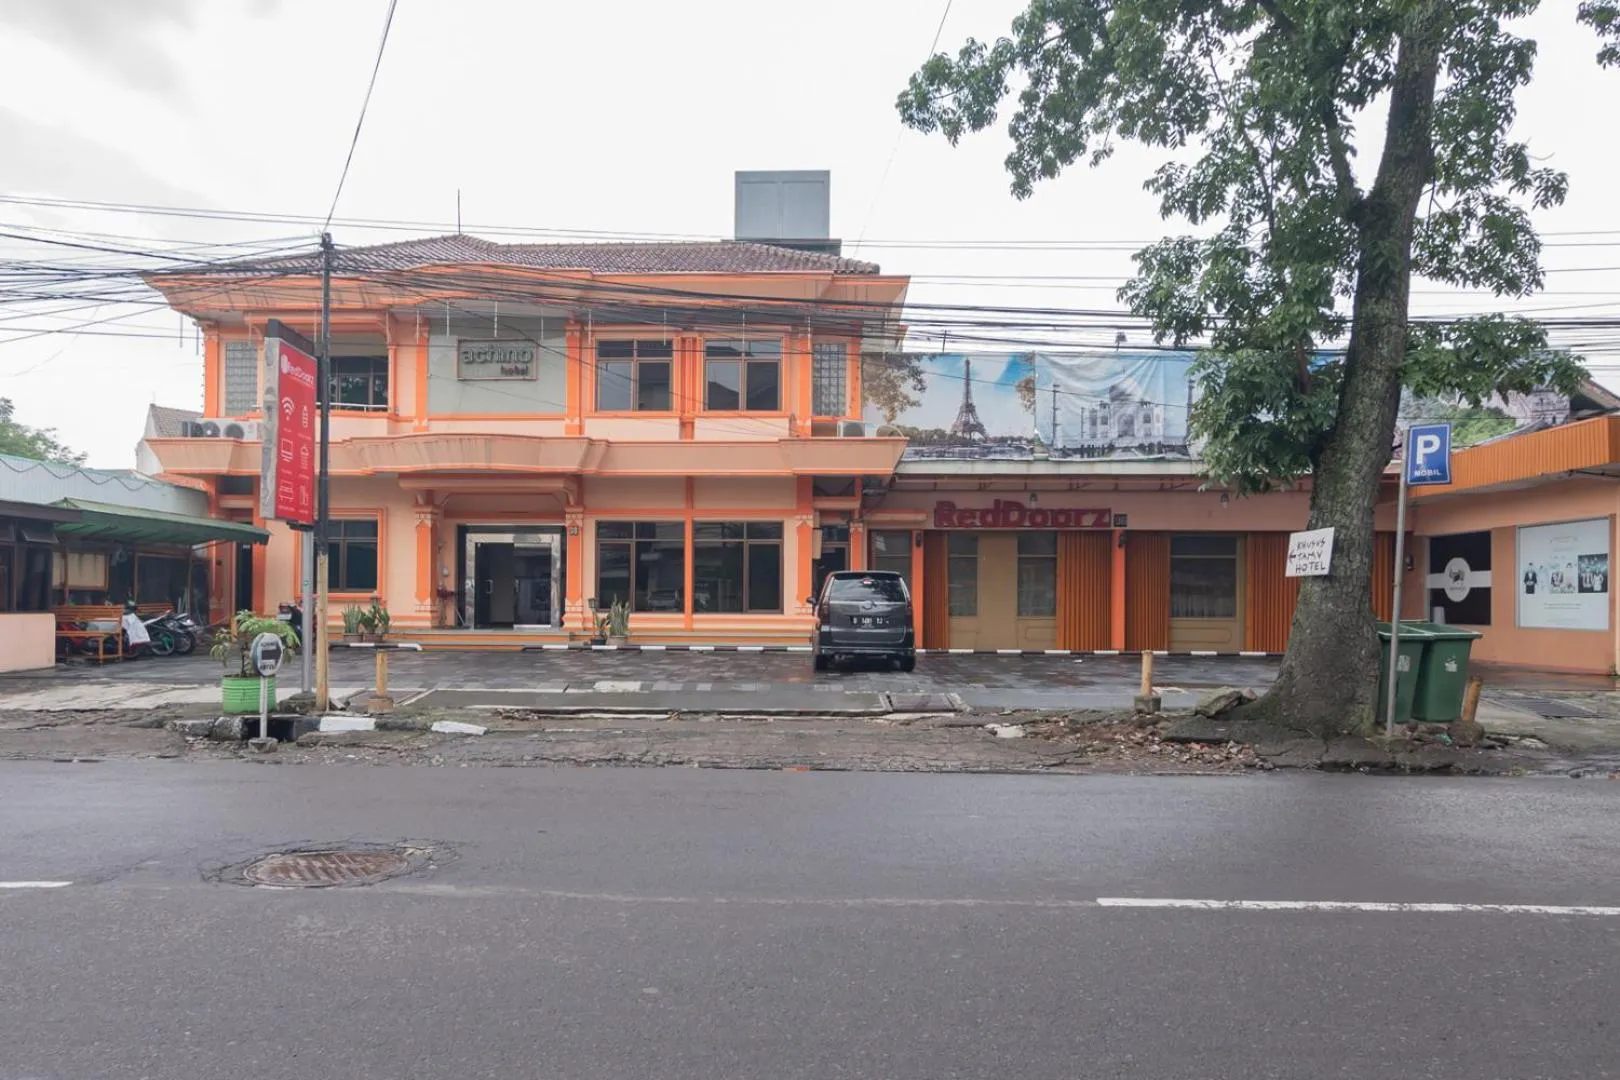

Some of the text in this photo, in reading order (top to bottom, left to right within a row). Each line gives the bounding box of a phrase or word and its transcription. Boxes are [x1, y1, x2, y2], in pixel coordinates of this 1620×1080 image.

[1416, 434, 1441, 465] P
[1414, 468, 1442, 477] MOBIL
[934, 499, 1111, 528] RedDoorz
[1295, 560, 1326, 573] HOTEL
